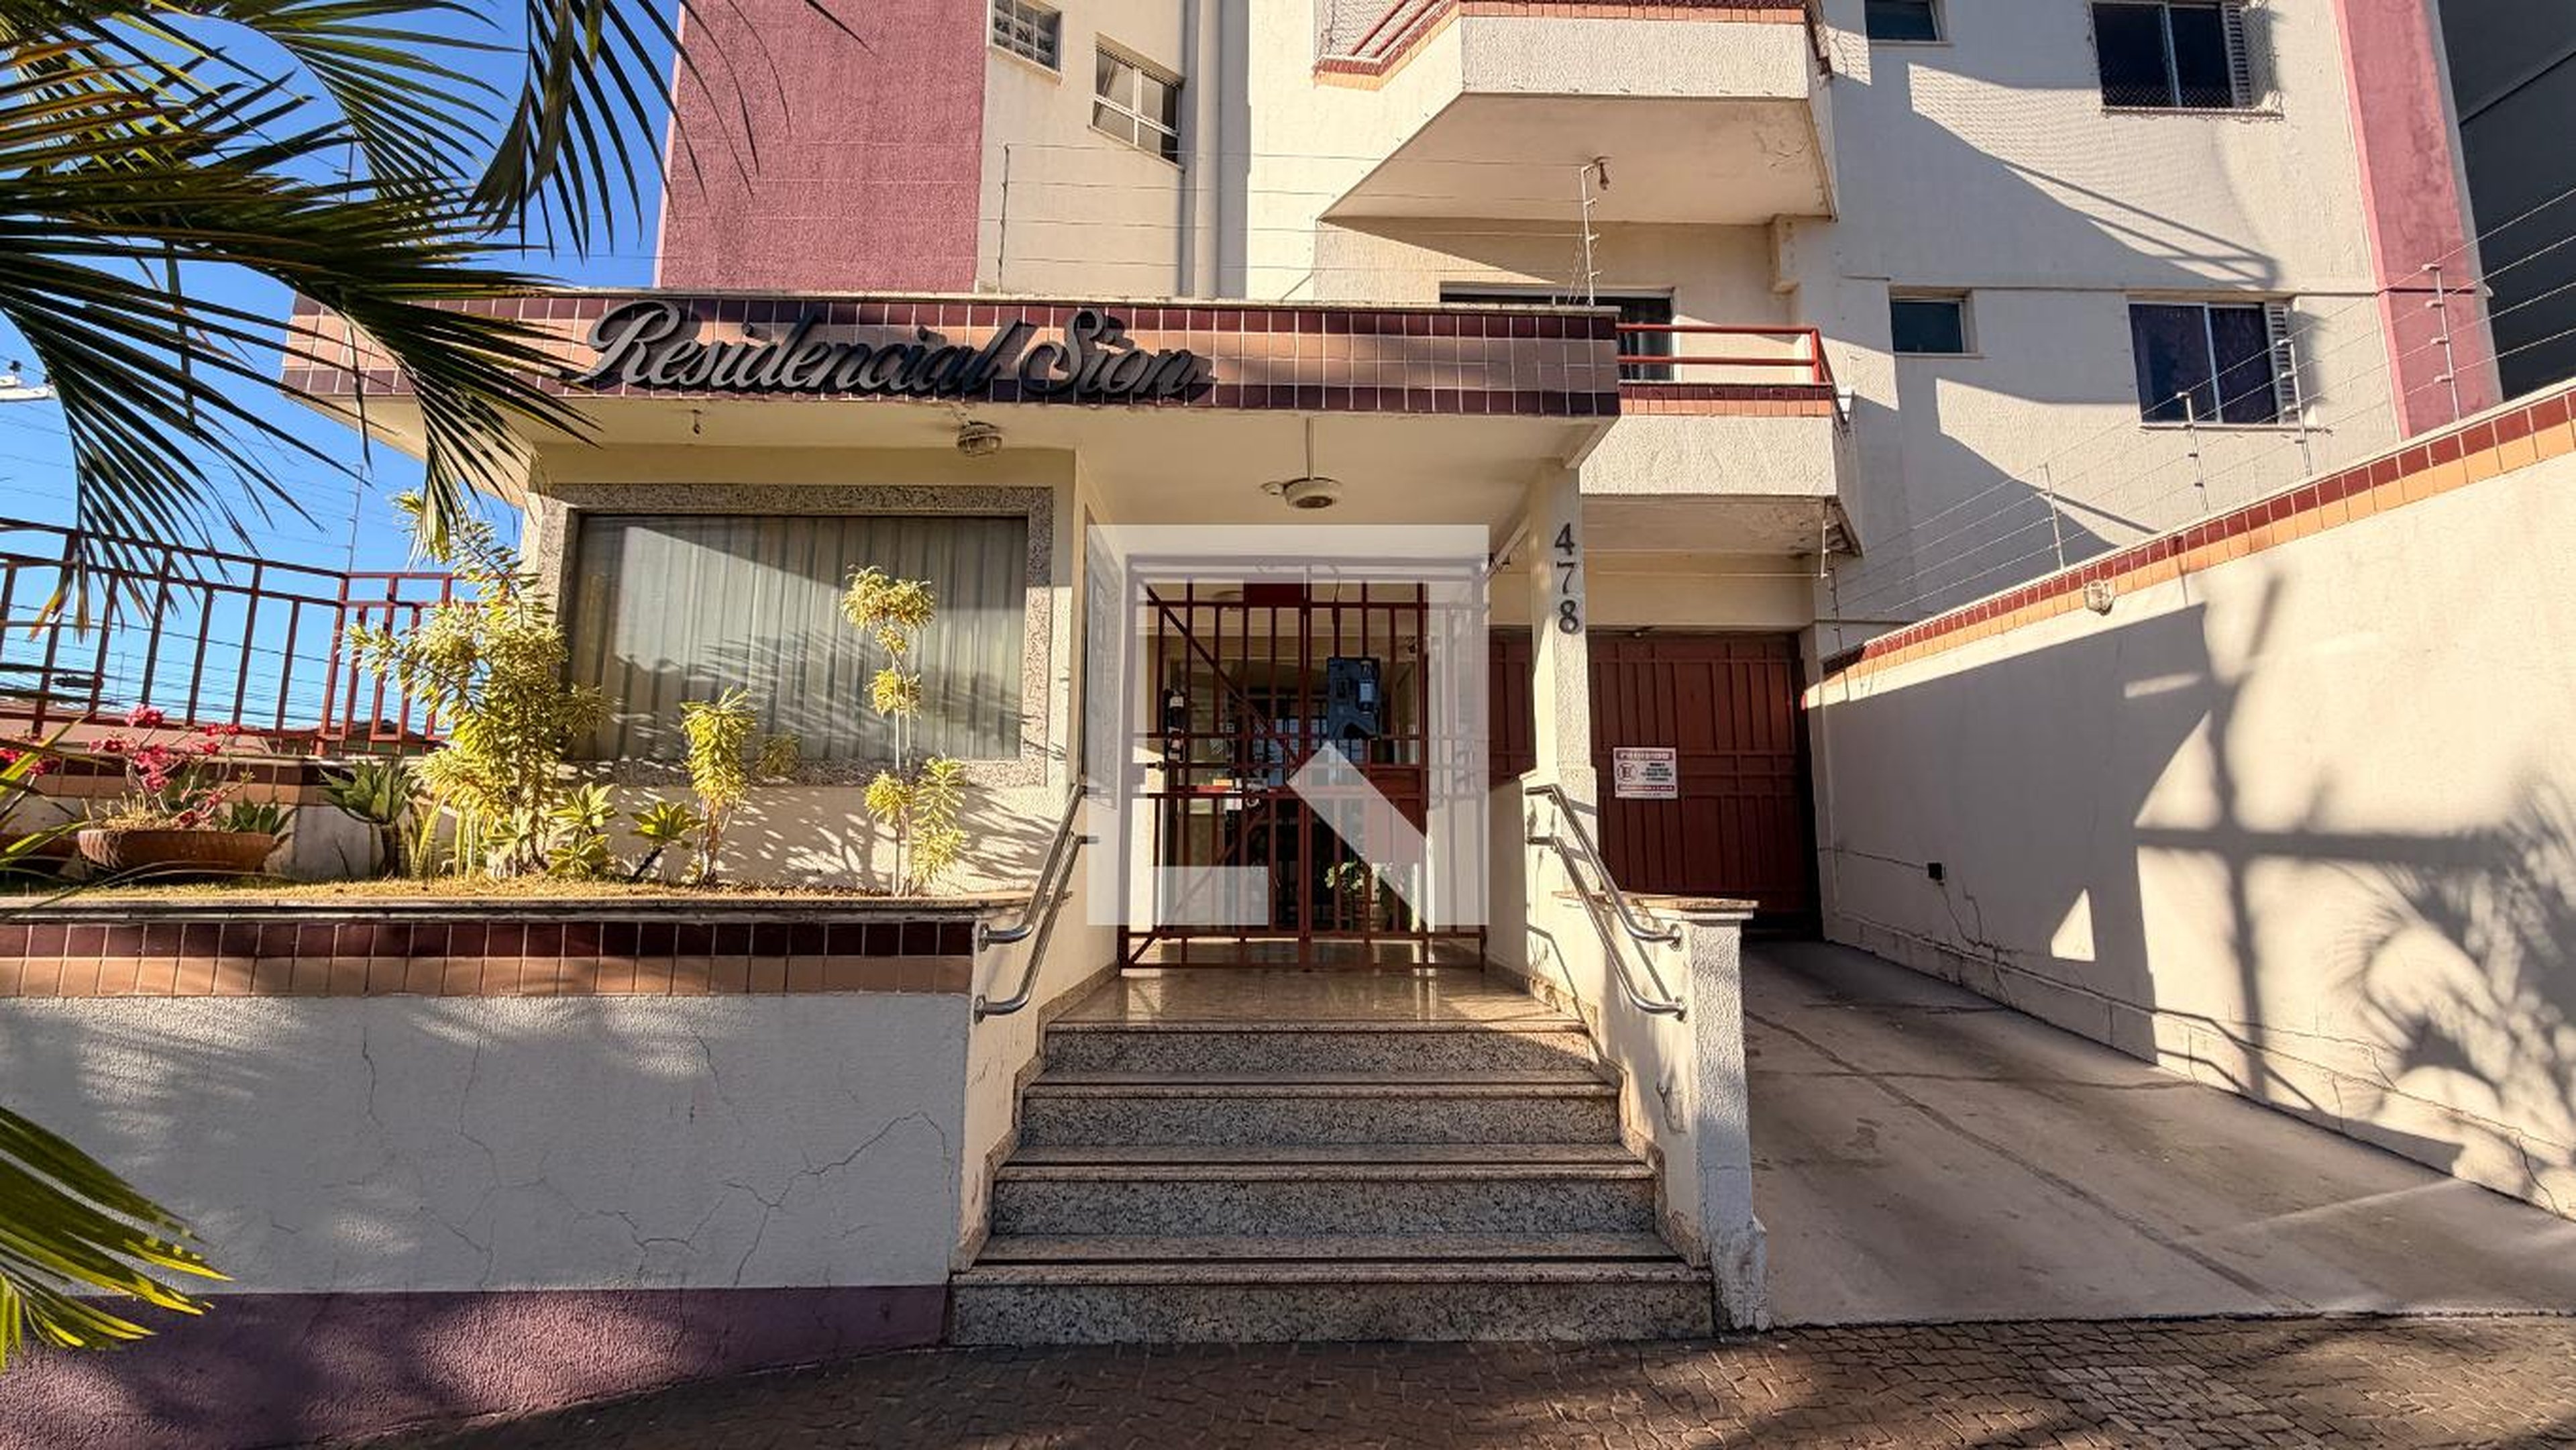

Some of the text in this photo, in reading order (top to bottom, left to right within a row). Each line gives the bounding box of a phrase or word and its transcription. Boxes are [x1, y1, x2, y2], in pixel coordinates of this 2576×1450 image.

[570, 299, 1203, 394] Residencial Sion
[1554, 523, 1578, 634] 478
